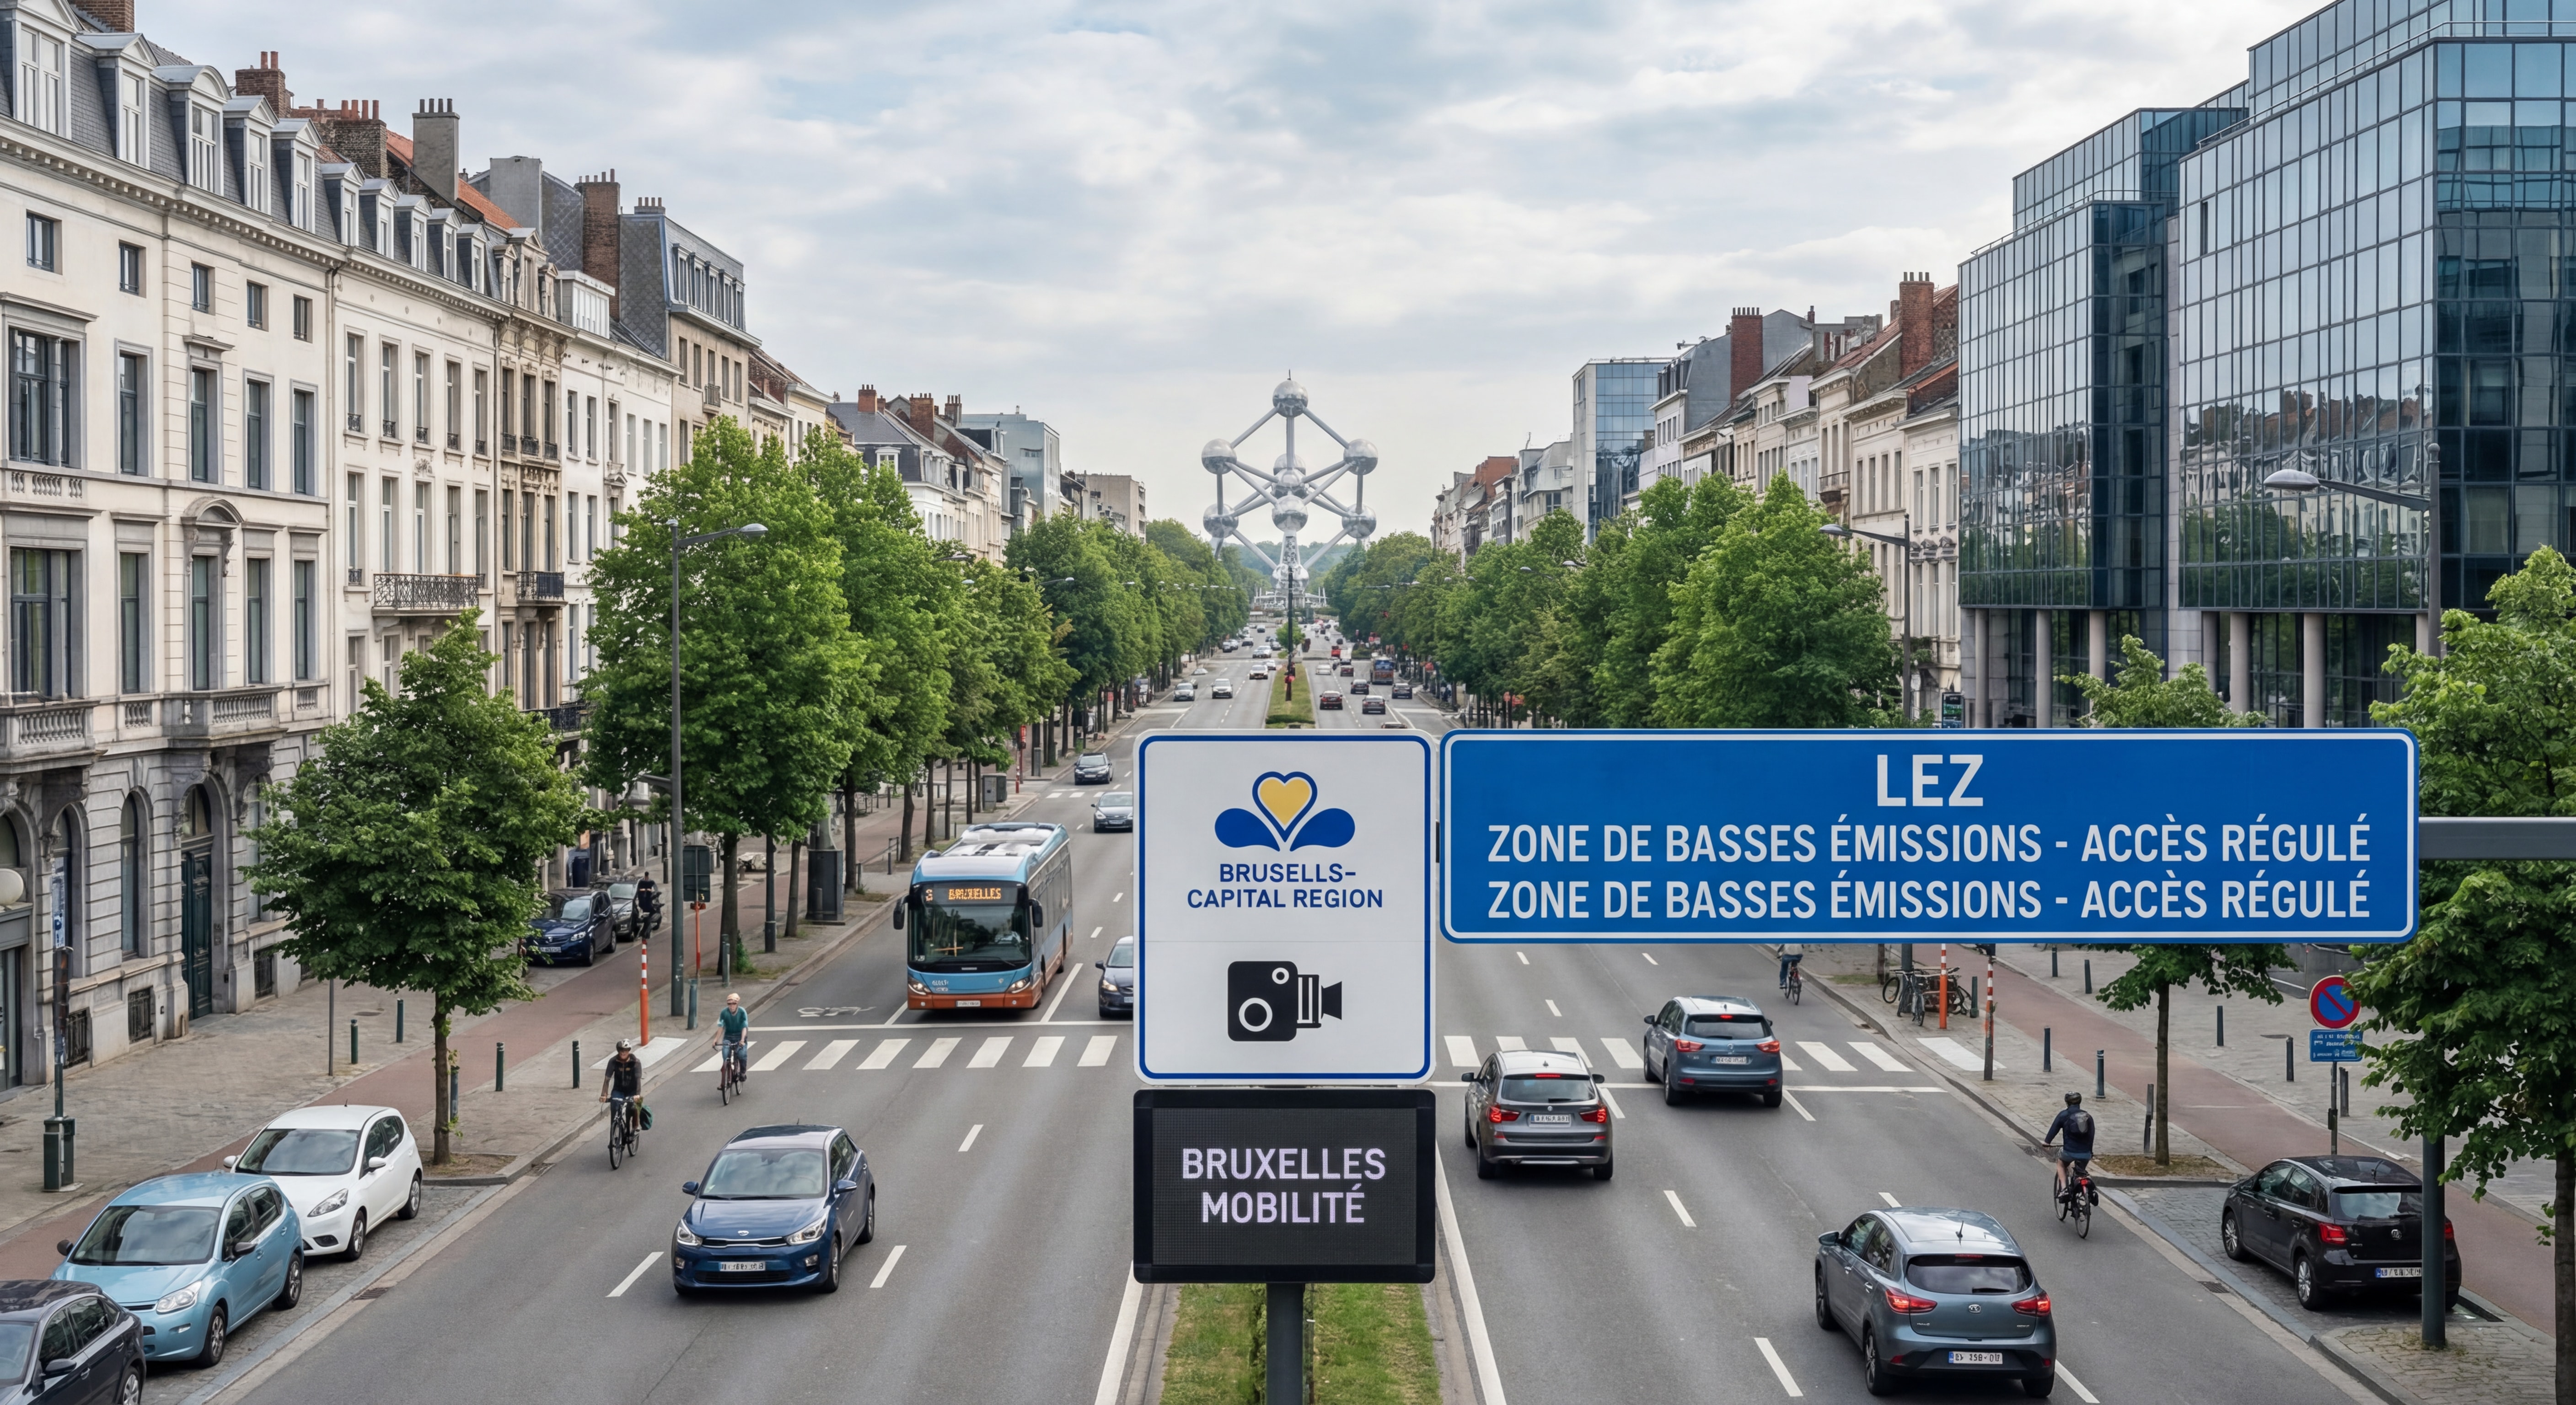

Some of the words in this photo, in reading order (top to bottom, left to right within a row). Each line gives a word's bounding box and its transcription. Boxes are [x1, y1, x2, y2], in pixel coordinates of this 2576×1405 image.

[1878, 755, 1983, 806] LEZ
[1489, 825, 1589, 862] ZONE
[1604, 825, 1652, 862] DE
[1667, 824, 1816, 862] BASSES
[1831, 814, 2041, 862] ÉMISSIONS
[2081, 814, 2207, 862] ACCÈS
[2222, 813, 2370, 862] RÉGULÉ
[1220, 863, 1356, 883] BRUSELLS-
[1187, 889, 1286, 908] CAPITAL
[1293, 889, 1382, 908] REGION
[1489, 881, 1589, 918] ZONE
[1604, 881, 1651, 918] DE
[1667, 880, 1816, 919] BASSES
[1831, 870, 2041, 918] ÉMISSIONS
[2081, 870, 2207, 918] ACCÈS
[2222, 869, 2369, 918] RÉGULÉ
[1182, 1148, 1385, 1180] BRUXELLES
[1202, 1183, 1365, 1223] MOBILITÉ
